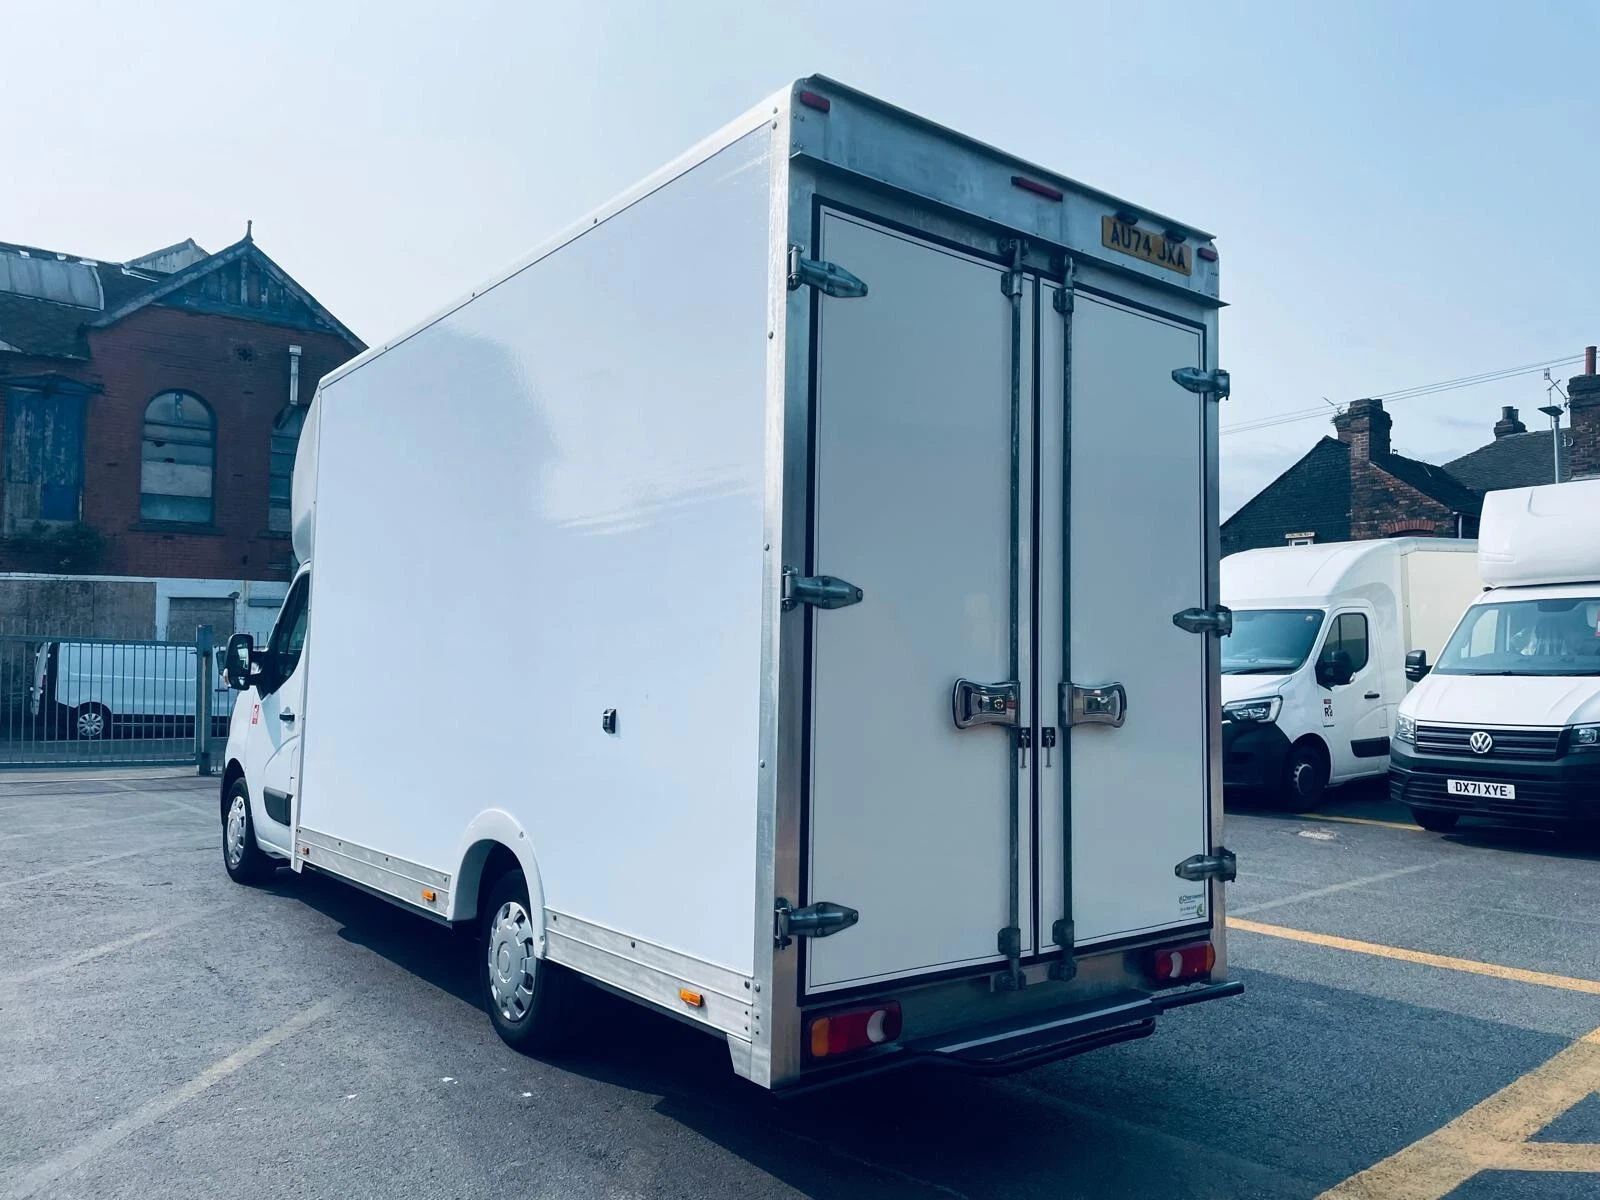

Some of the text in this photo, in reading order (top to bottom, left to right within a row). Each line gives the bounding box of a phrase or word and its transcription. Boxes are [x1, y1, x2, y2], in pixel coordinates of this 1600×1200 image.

[1111, 222, 1185, 268] AU74 JXA
[1470, 731, 1492, 753] VW
[1455, 782, 1507, 796] DX71 XYE
